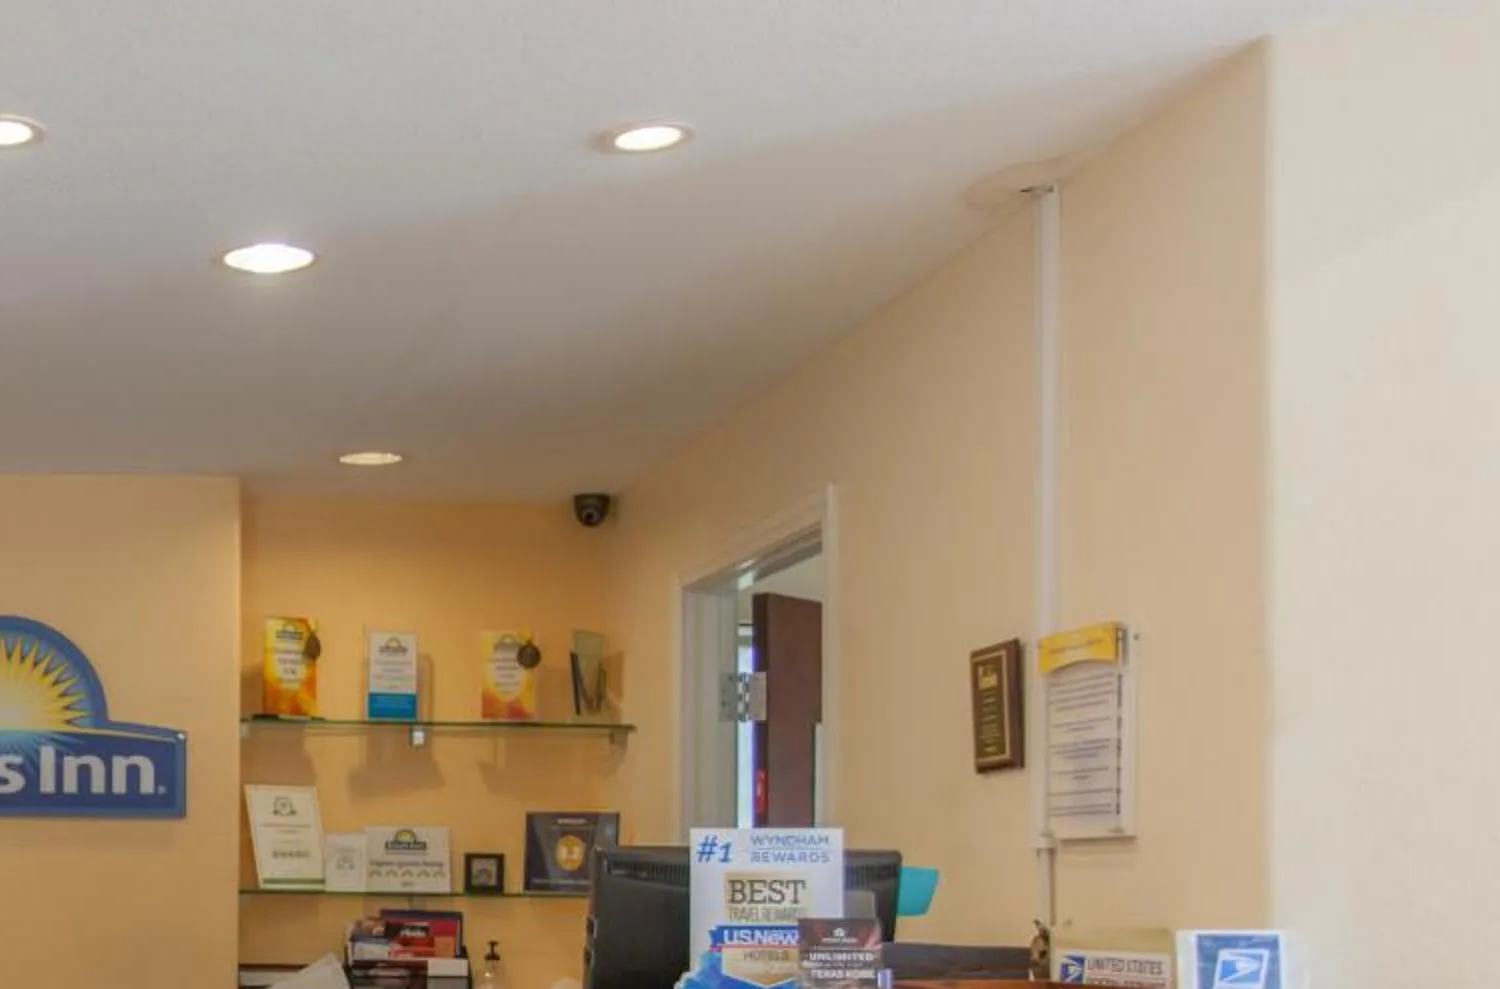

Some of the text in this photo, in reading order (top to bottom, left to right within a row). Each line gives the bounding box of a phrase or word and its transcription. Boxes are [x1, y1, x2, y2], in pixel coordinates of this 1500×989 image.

[39, 746, 157, 795] Inn
[696, 834, 830, 863] #1 WYNDHAM
[750, 850, 831, 863] REWARDS
[727, 879, 807, 905] BEST
[808, 951, 876, 961] UNLIMITED
